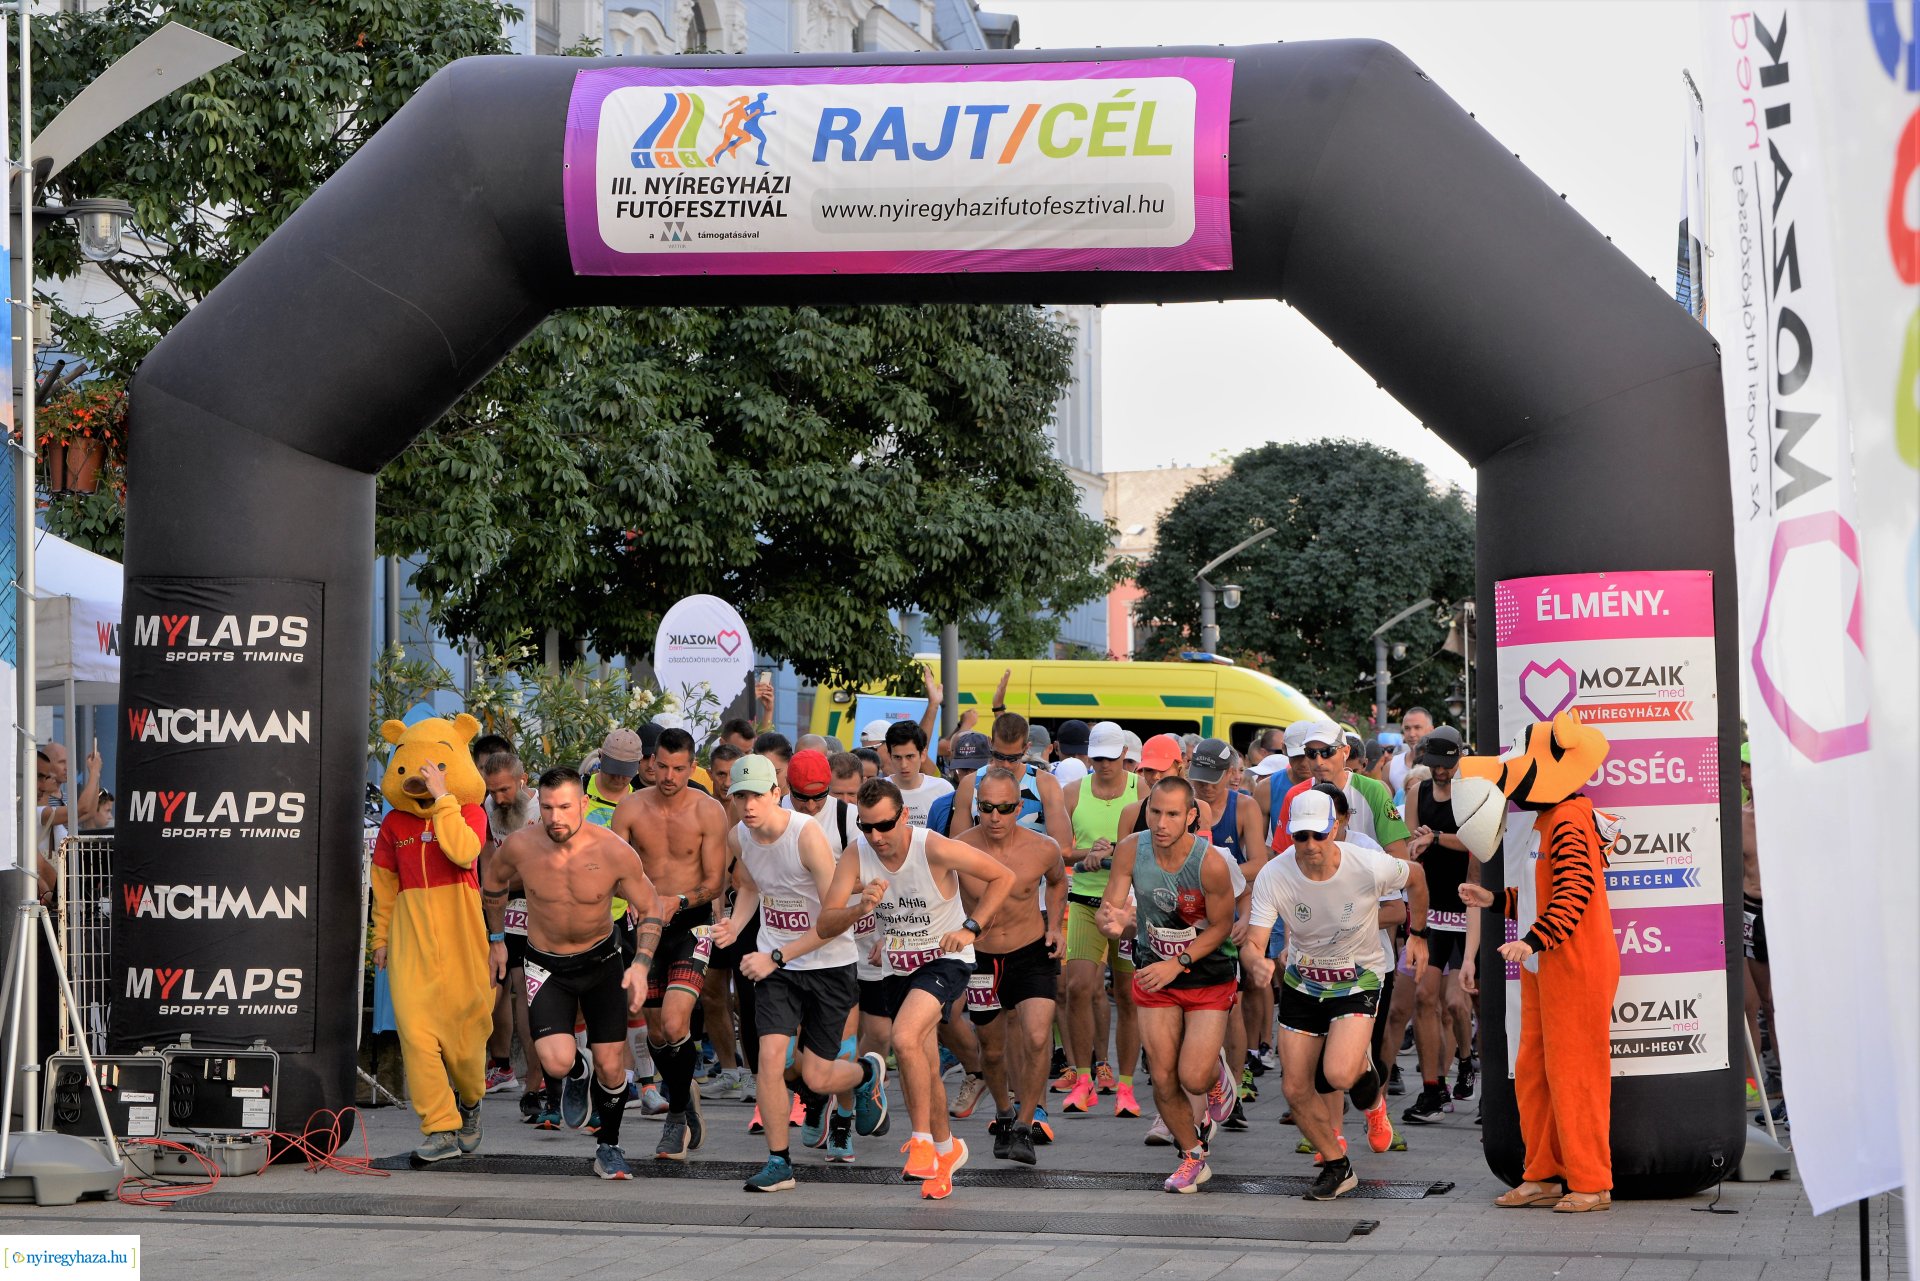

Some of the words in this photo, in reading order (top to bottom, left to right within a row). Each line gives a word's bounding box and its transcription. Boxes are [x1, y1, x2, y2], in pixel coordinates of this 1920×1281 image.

[812, 88, 1173, 164] RAJT/CÉL
[611, 177, 637, 195] III.
[645, 171, 791, 195] NYÍREGYHÁZI
[616, 196, 788, 218] FUTÓFESZTIVÁL
[821, 194, 1166, 222] www.nyiregyhazifutofesztival.hu
[698, 231, 760, 240] támogatásával
[1536, 584, 1670, 621] ÉLMÉNY.
[134, 615, 309, 647] MYLAPS
[166, 651, 234, 662] SPORTS
[243, 651, 304, 663] TIMING
[1579, 665, 1684, 690] MOZAIK
[1658, 687, 1685, 698] med
[1580, 705, 1671, 720] NYÍREGYHÁZA
[128, 708, 310, 744] WATCHMAN
[129, 791, 306, 823] MYLAPS
[162, 828, 231, 838] SPORTS
[239, 828, 301, 839] TIMING
[1613, 832, 1692, 855] OZAIK
[1666, 853, 1693, 865] med
[124, 884, 308, 920] WATCHMAN
[899, 897, 927, 908] Attila
[766, 908, 809, 928] 21160
[125, 967, 303, 1000] MYLAPS
[1299, 967, 1355, 981] 21119
[159, 1005, 229, 1016] SPORTS
[237, 1005, 298, 1016] TIMING
[1673, 1019, 1699, 1031] med
